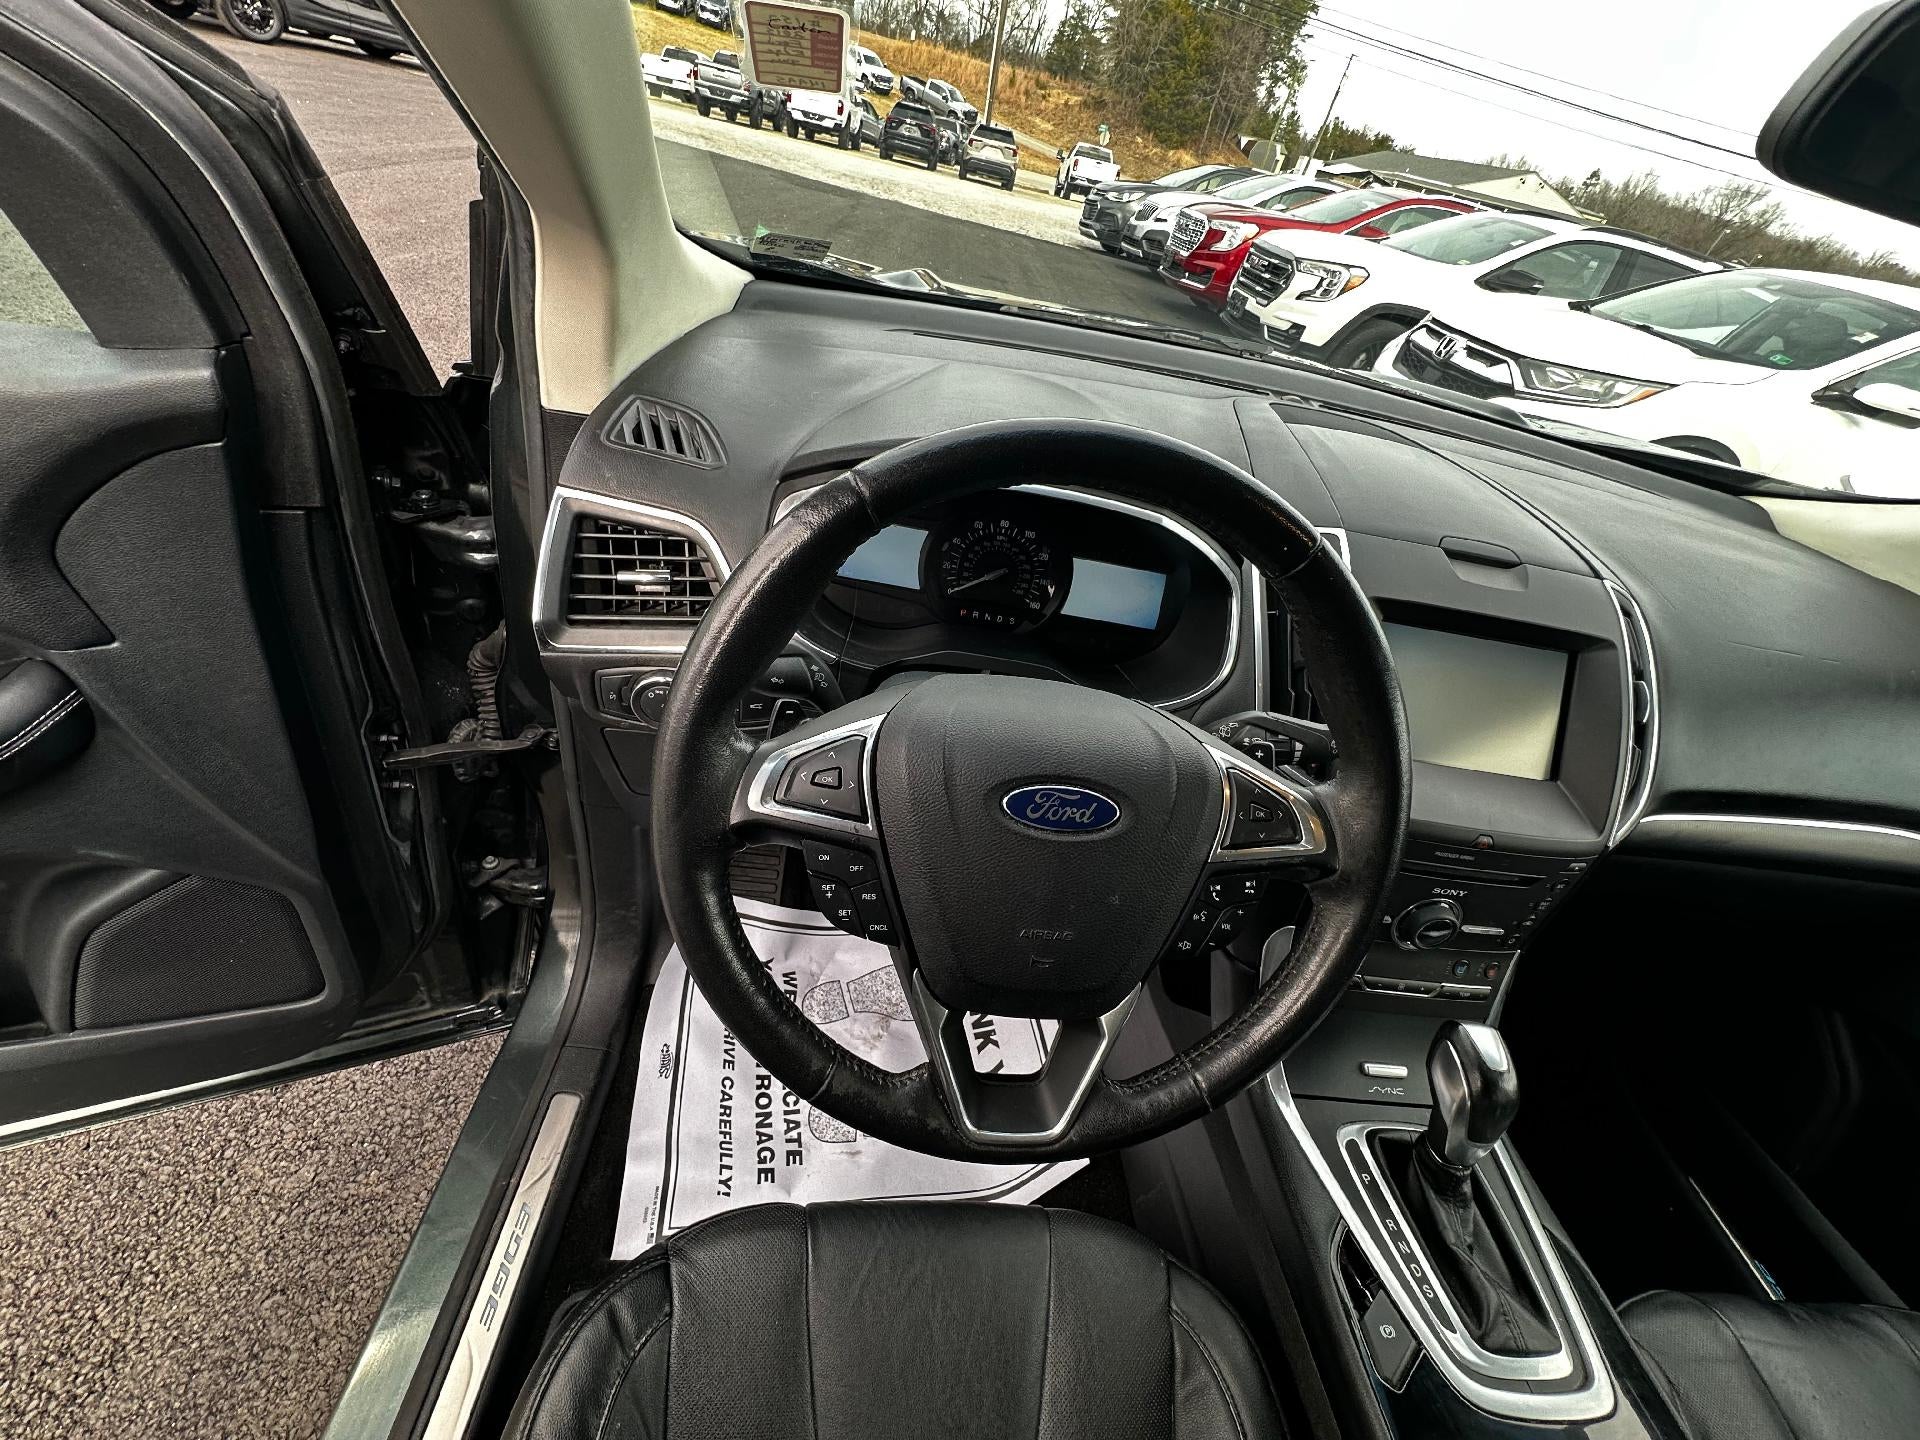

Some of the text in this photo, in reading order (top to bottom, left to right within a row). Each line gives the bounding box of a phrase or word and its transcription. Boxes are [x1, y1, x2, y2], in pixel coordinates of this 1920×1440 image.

[1000, 520, 1010, 528] 80
[1026, 790, 1098, 824] Ford
[1255, 810, 1266, 818] OK
[818, 854, 830, 862] ON
[861, 893, 877, 901] RES
[1431, 887, 1469, 897] SONY
[838, 909, 852, 917] SET
[869, 924, 889, 932] CNCL
[1018, 928, 1074, 942] AIRBAG
[1368, 1086, 1405, 1095] SYNC
[755, 1063, 776, 1185] RONAGE
[782, 1085, 804, 1167] CIATE
[716, 1075, 735, 1198] CAREFULLY!
[1361, 1173, 1434, 1298] P R N D S
[480, 1202, 531, 1332] EDGE
